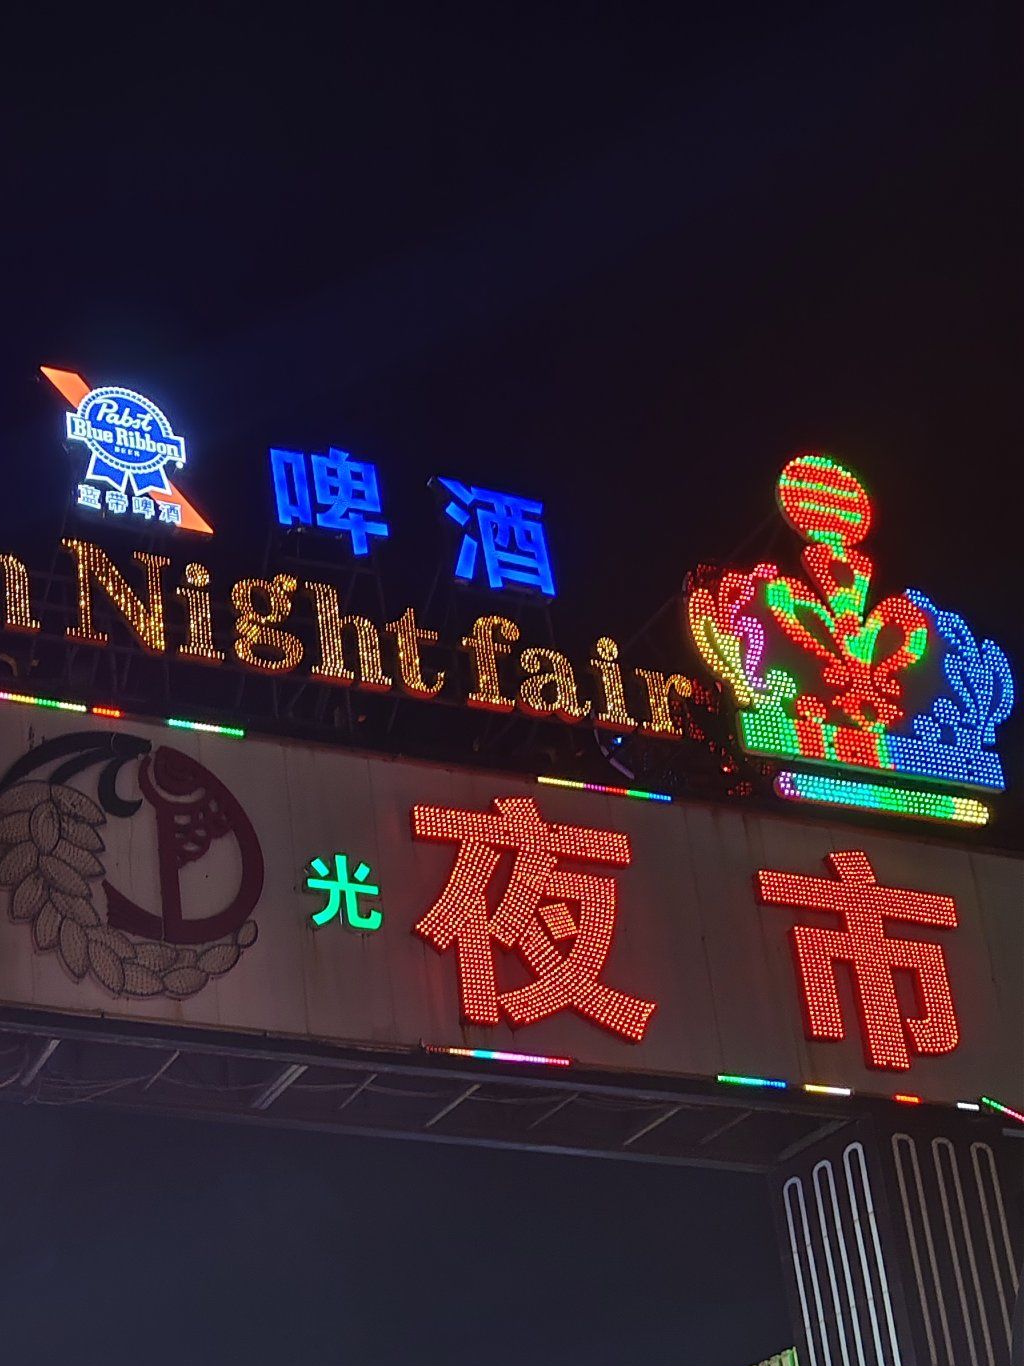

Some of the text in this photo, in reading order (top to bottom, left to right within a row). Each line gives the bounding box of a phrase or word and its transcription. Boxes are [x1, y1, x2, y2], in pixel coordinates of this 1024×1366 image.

[96, 399, 153, 432] Pabst
[73, 418, 179, 457] Blue Ribbon
[114, 446, 141, 458] BEER
[77, 484, 182, 527] 蓝带啤酒
[270, 447, 557, 597] 啤酒
[61, 539, 446, 696] Night
[462, 614, 693, 735] fair
[413, 797, 961, 1073] 夜市
